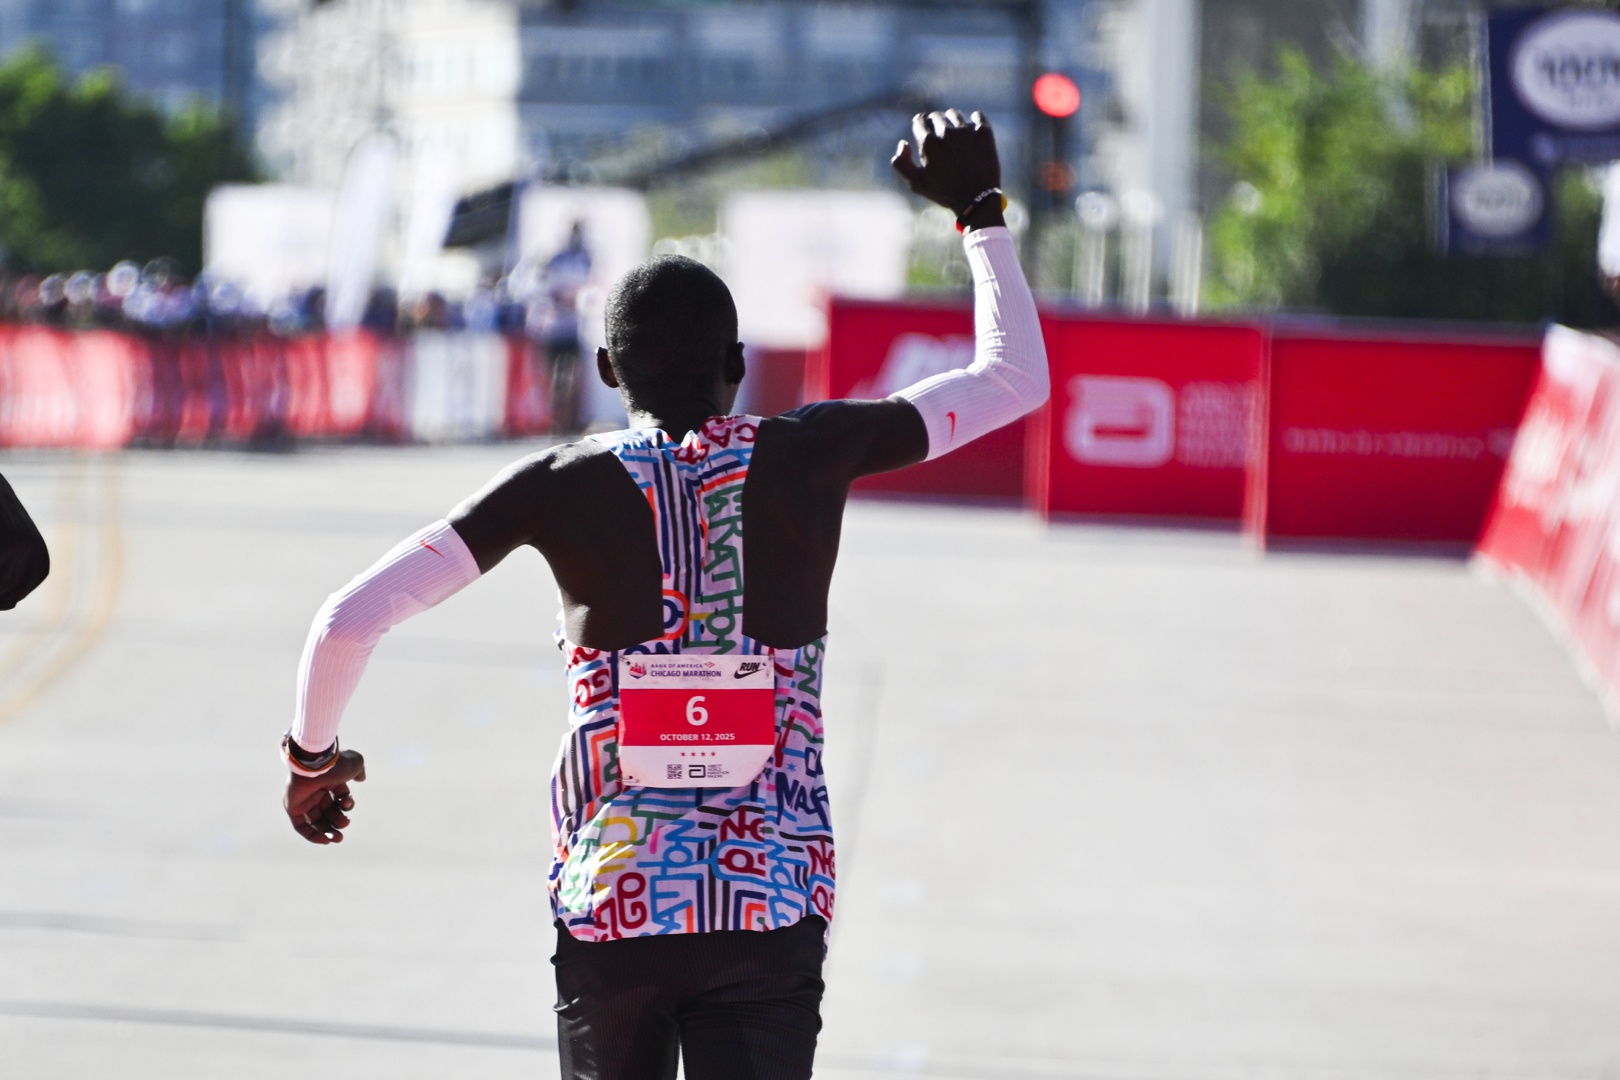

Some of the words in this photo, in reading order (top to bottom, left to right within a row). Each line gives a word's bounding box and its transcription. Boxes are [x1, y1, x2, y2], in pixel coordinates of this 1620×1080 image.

[740, 662, 760, 672] RUN
[686, 695, 709, 727] 6
[660, 733, 699, 741] OCTOBER
[701, 733, 713, 742] 12,
[715, 733, 735, 741] 2025
